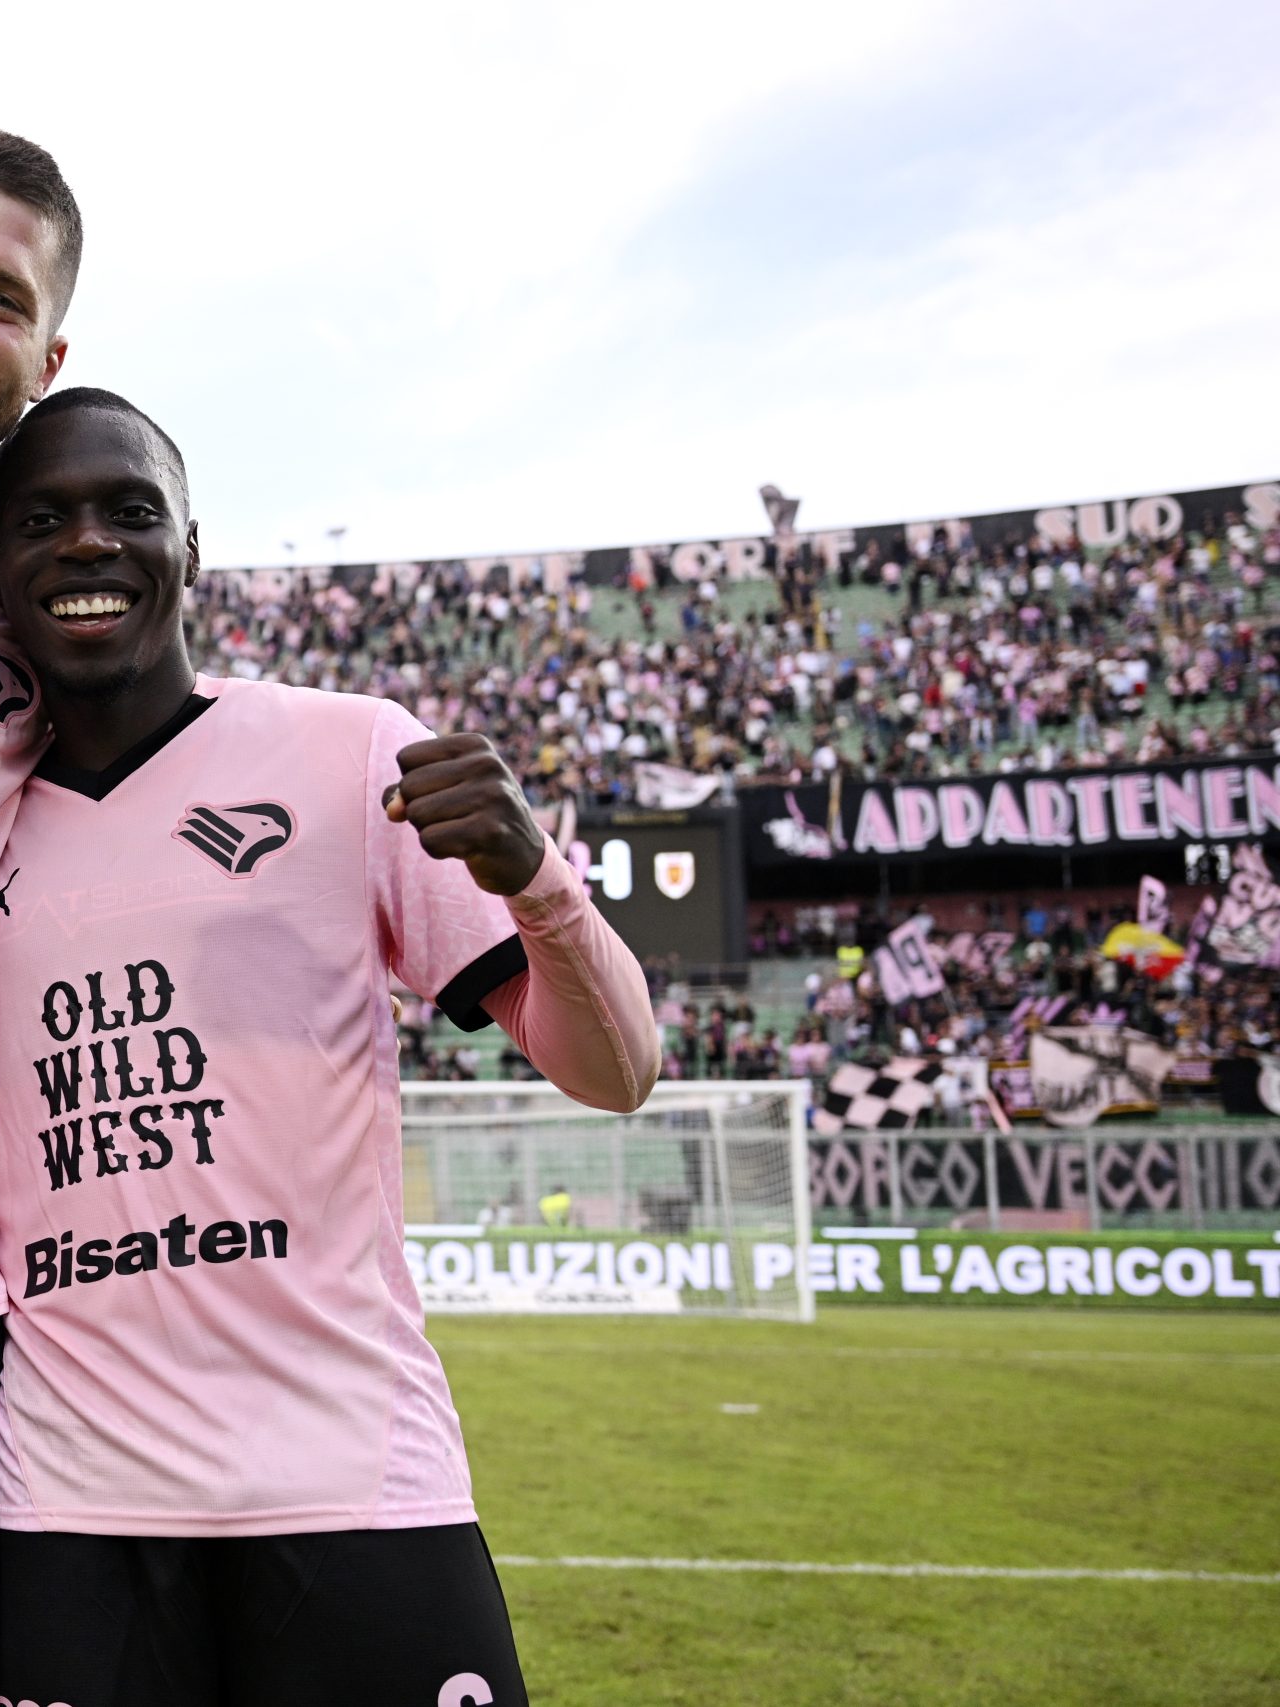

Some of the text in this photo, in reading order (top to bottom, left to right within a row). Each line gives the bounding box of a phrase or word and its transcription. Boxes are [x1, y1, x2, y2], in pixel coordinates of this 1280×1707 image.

[853, 766, 1280, 854] APPARTENEN
[42, 960, 175, 1041] OLD
[33, 1027, 207, 1119] WILD
[38, 1099, 224, 1191] WEST
[24, 1214, 287, 1299] Bisaten
[753, 1243, 883, 1292] PER
